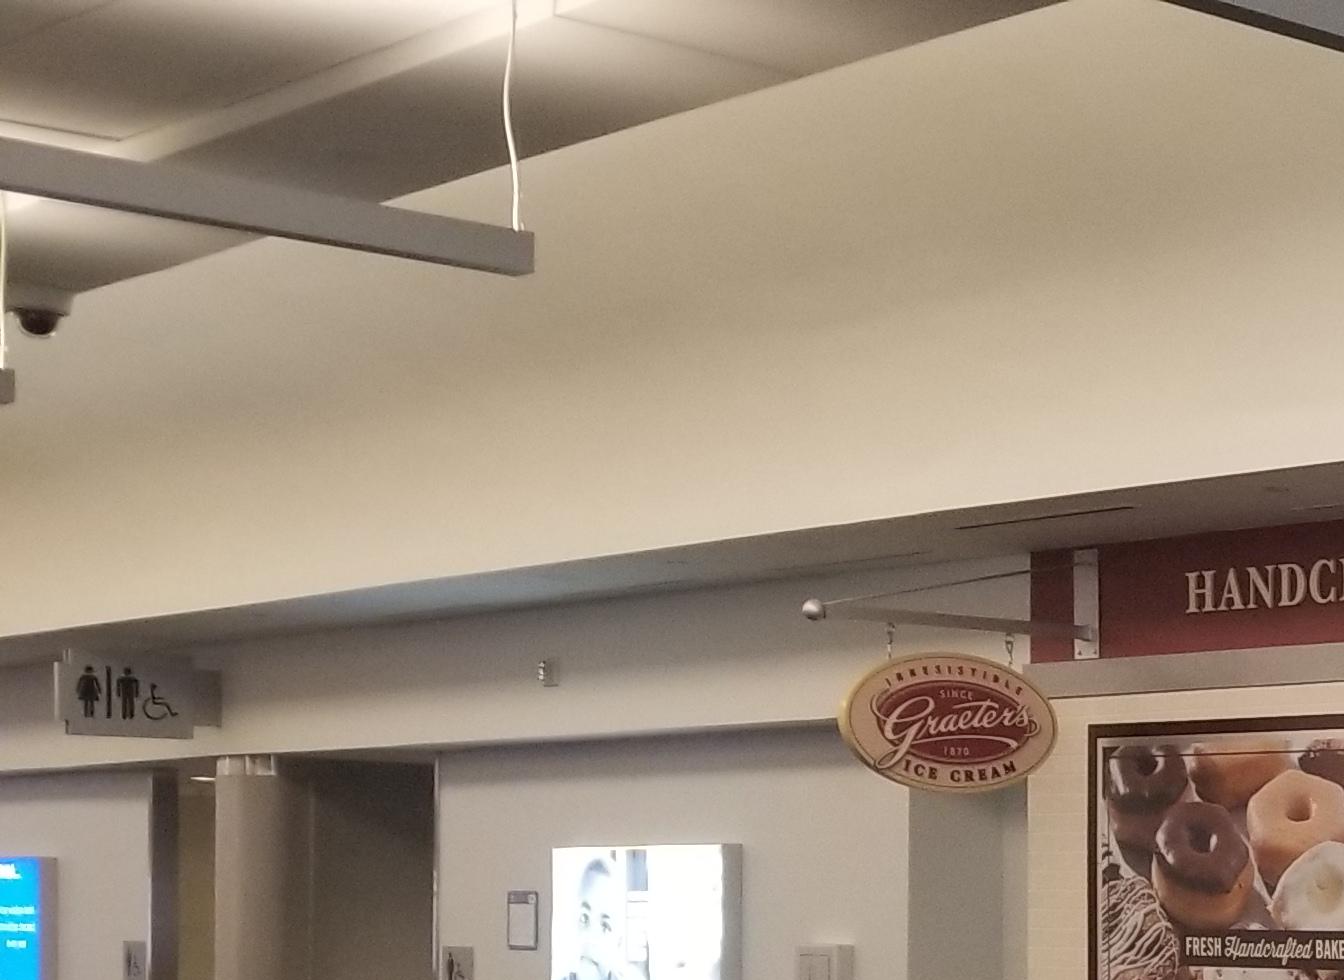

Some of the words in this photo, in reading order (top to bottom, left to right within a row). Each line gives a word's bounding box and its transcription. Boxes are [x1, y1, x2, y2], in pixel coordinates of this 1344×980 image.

[885, 664, 1024, 697] IRRESISTIBLE
[938, 688, 975, 700] SINCE
[869, 694, 1042, 770] Graeter's
[943, 746, 970, 757] 1870
[902, 758, 938, 781] ICE
[949, 760, 1017, 783] CREAM
[1185, 936, 1222, 957] FRESH
[1224, 935, 1314, 967] Handcrafted
